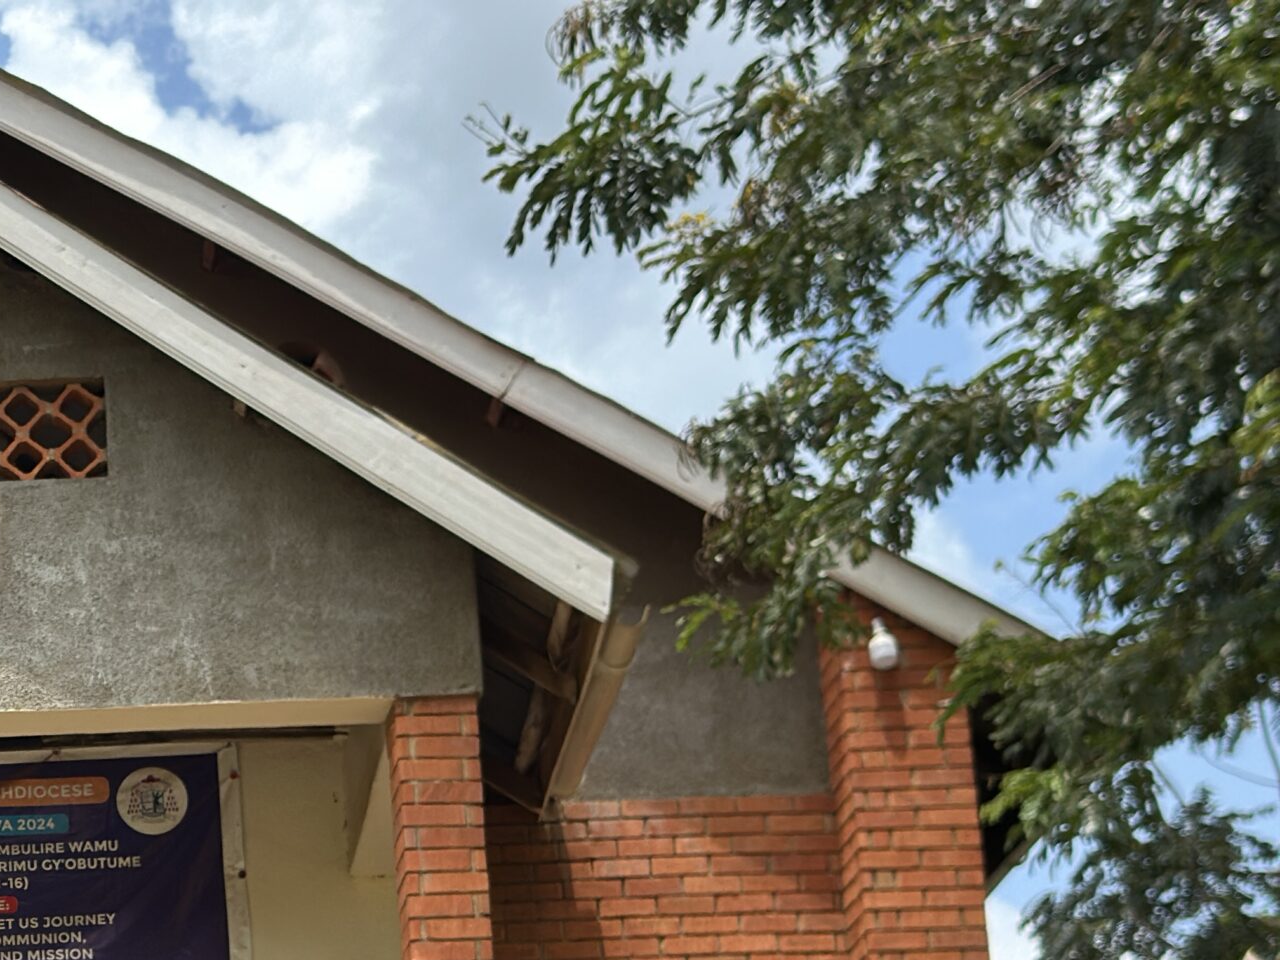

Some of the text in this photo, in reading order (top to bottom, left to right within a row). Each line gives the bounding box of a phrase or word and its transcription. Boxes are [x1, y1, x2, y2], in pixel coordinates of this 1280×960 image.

[16, 818, 55, 831] 2024
[68, 840, 119, 852] WAMU
[18, 917, 39, 929] US
[43, 913, 116, 927] JOURNEY
[27, 948, 94, 960] MISSION
